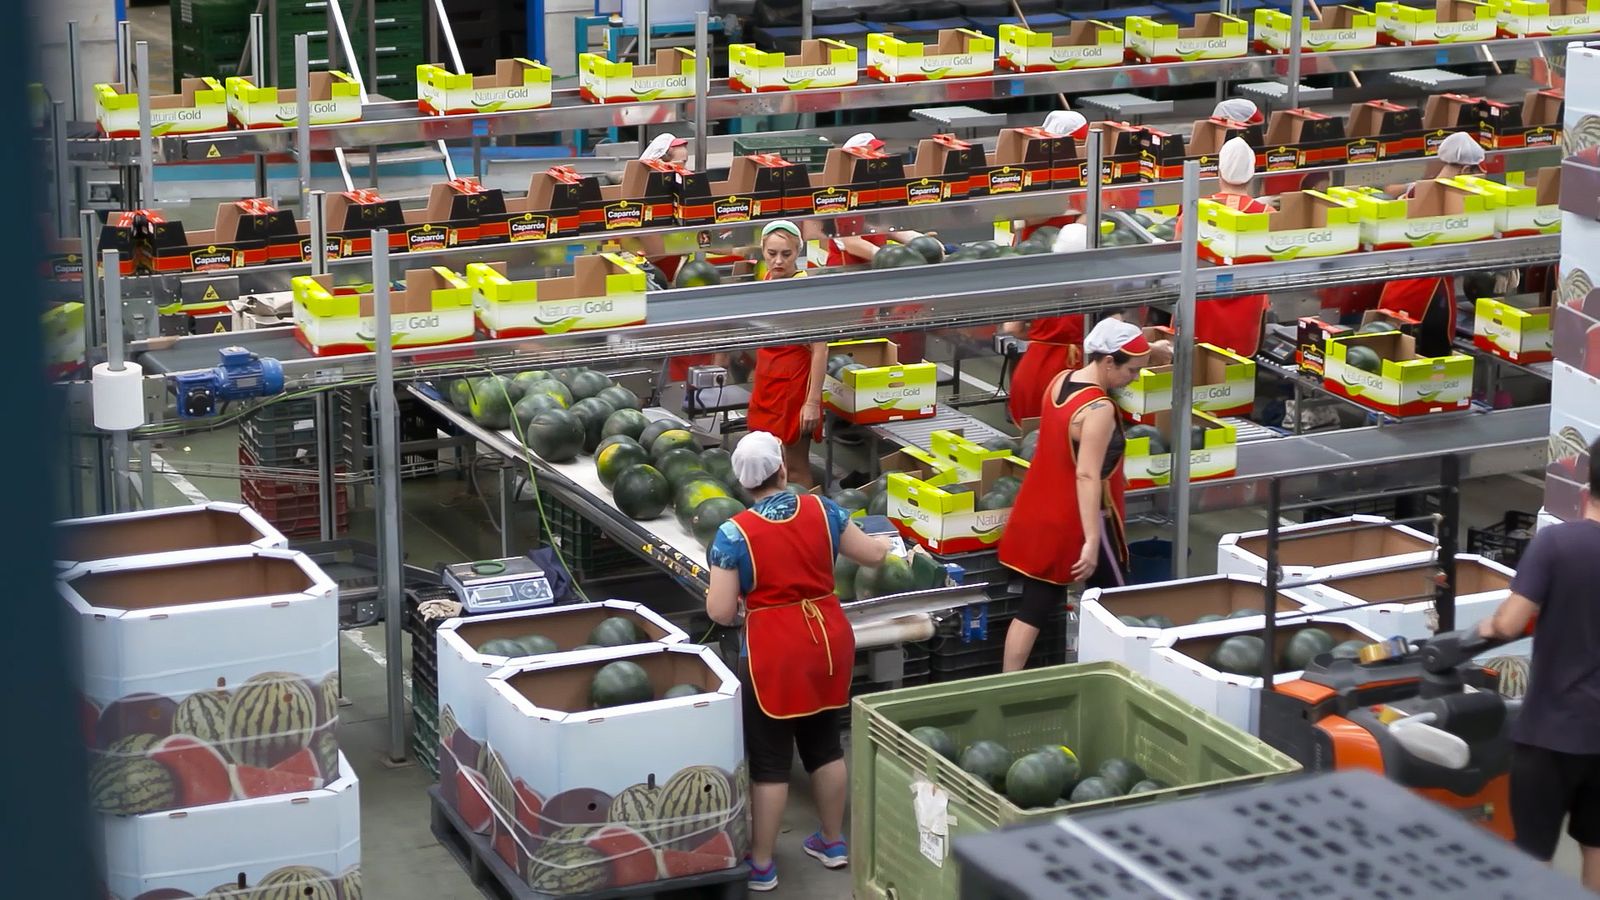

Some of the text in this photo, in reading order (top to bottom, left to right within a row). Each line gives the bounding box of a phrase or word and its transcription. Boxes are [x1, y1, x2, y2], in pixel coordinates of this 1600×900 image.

[1574, 16, 1590, 26] Gold
[1462, 22, 1480, 33] Gold
[1338, 31, 1357, 41] Gold
[1208, 39, 1227, 49] Gold
[1053, 48, 1102, 59] Natural Gold
[923, 56, 973, 68] Natural Gold
[786, 67, 836, 79] Natural Gold
[634, 78, 687, 90] Natural Gold
[475, 89, 528, 101] Natural Gold
[178, 107, 200, 120] Gold
[314, 103, 336, 113] Gold
[910, 186, 939, 195] Caparrós
[608, 207, 640, 218] Caparrós
[717, 203, 748, 213] Caparrós
[512, 220, 545, 231] Caparrós
[1445, 218, 1469, 230] Gold
[411, 231, 444, 242] Caparrós
[1308, 231, 1332, 243] Gold
[195, 254, 230, 264] Caparrós
[584, 301, 613, 313] Gold
[409, 317, 440, 329] Gold
[1367, 376, 1383, 389] Gold
[903, 388, 921, 397] Gold
[1209, 386, 1230, 398] Gold
